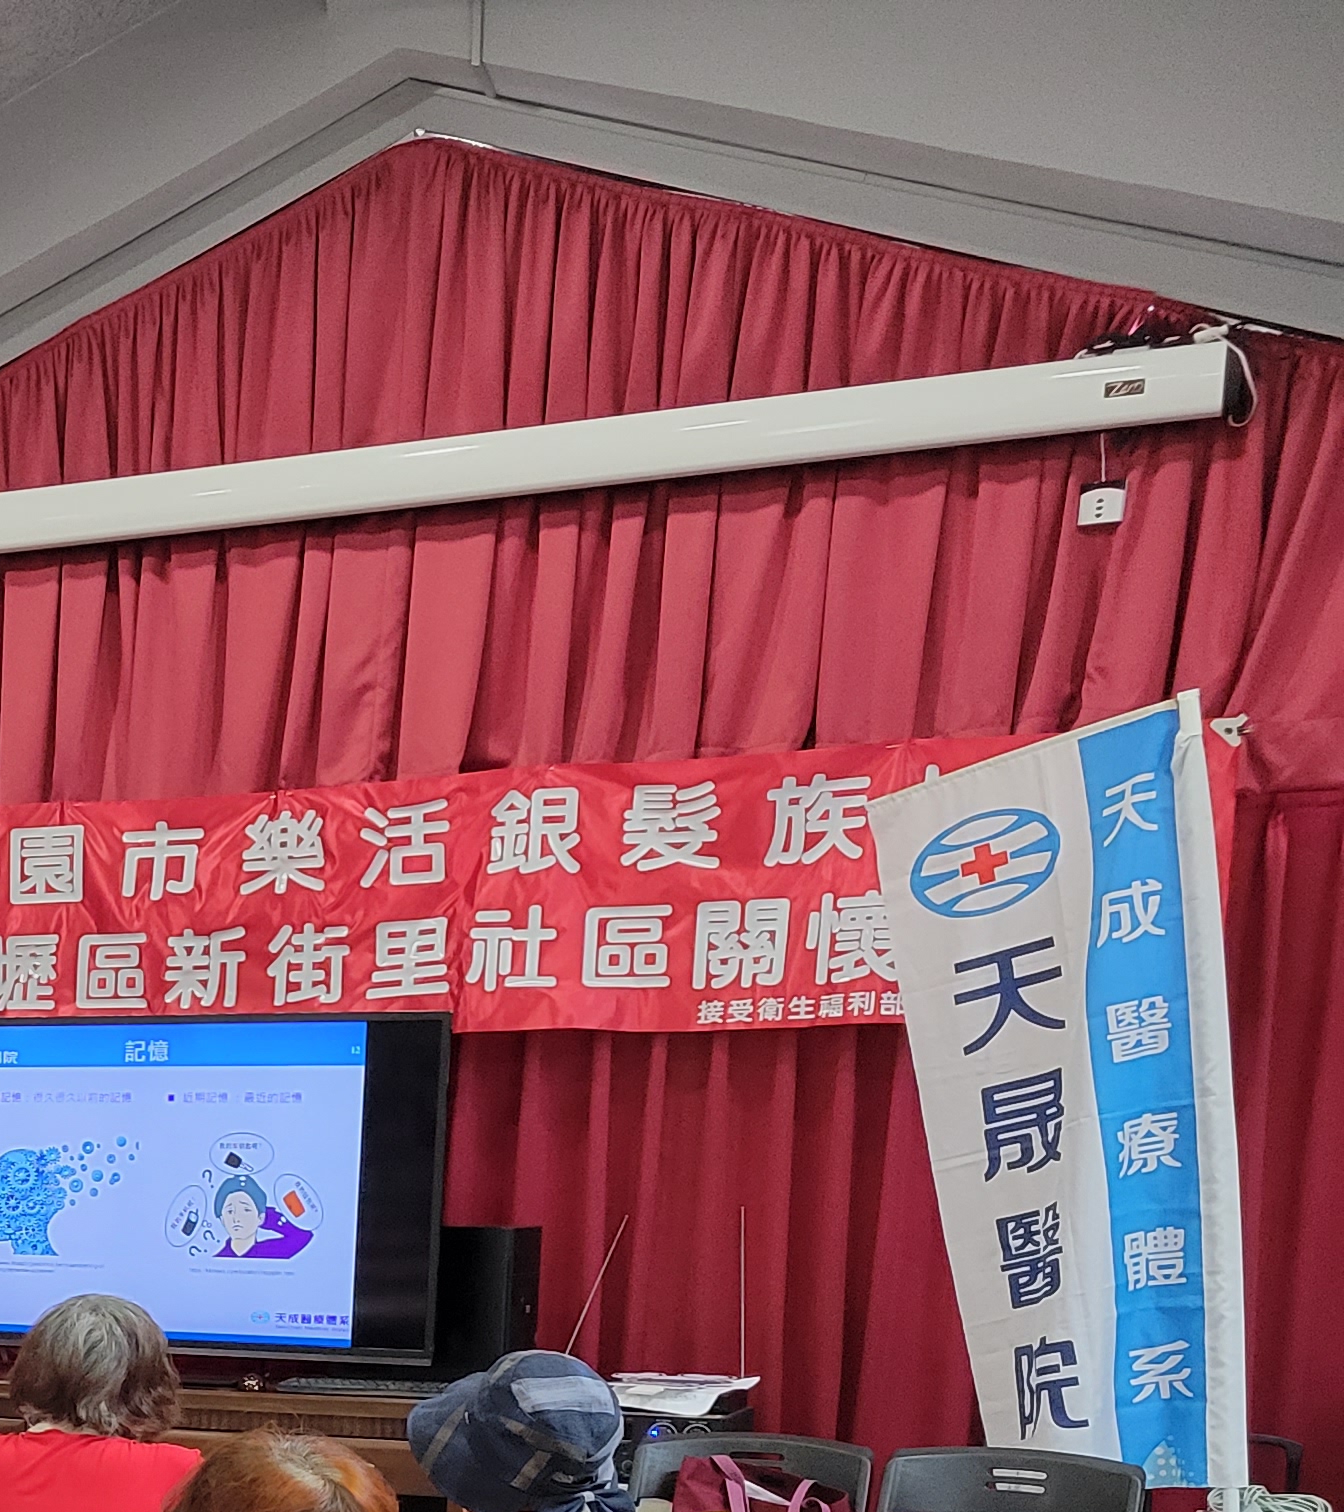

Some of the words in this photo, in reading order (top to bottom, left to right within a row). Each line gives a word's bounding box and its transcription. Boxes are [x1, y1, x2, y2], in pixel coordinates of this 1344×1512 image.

[124, 1039, 169, 1063] 記憶
[696, 990, 905, 1025] 接受衛生福利部
[1095, 770, 1195, 1406] 天成醫療體系
[953, 935, 1090, 1441] 天晟醫院
